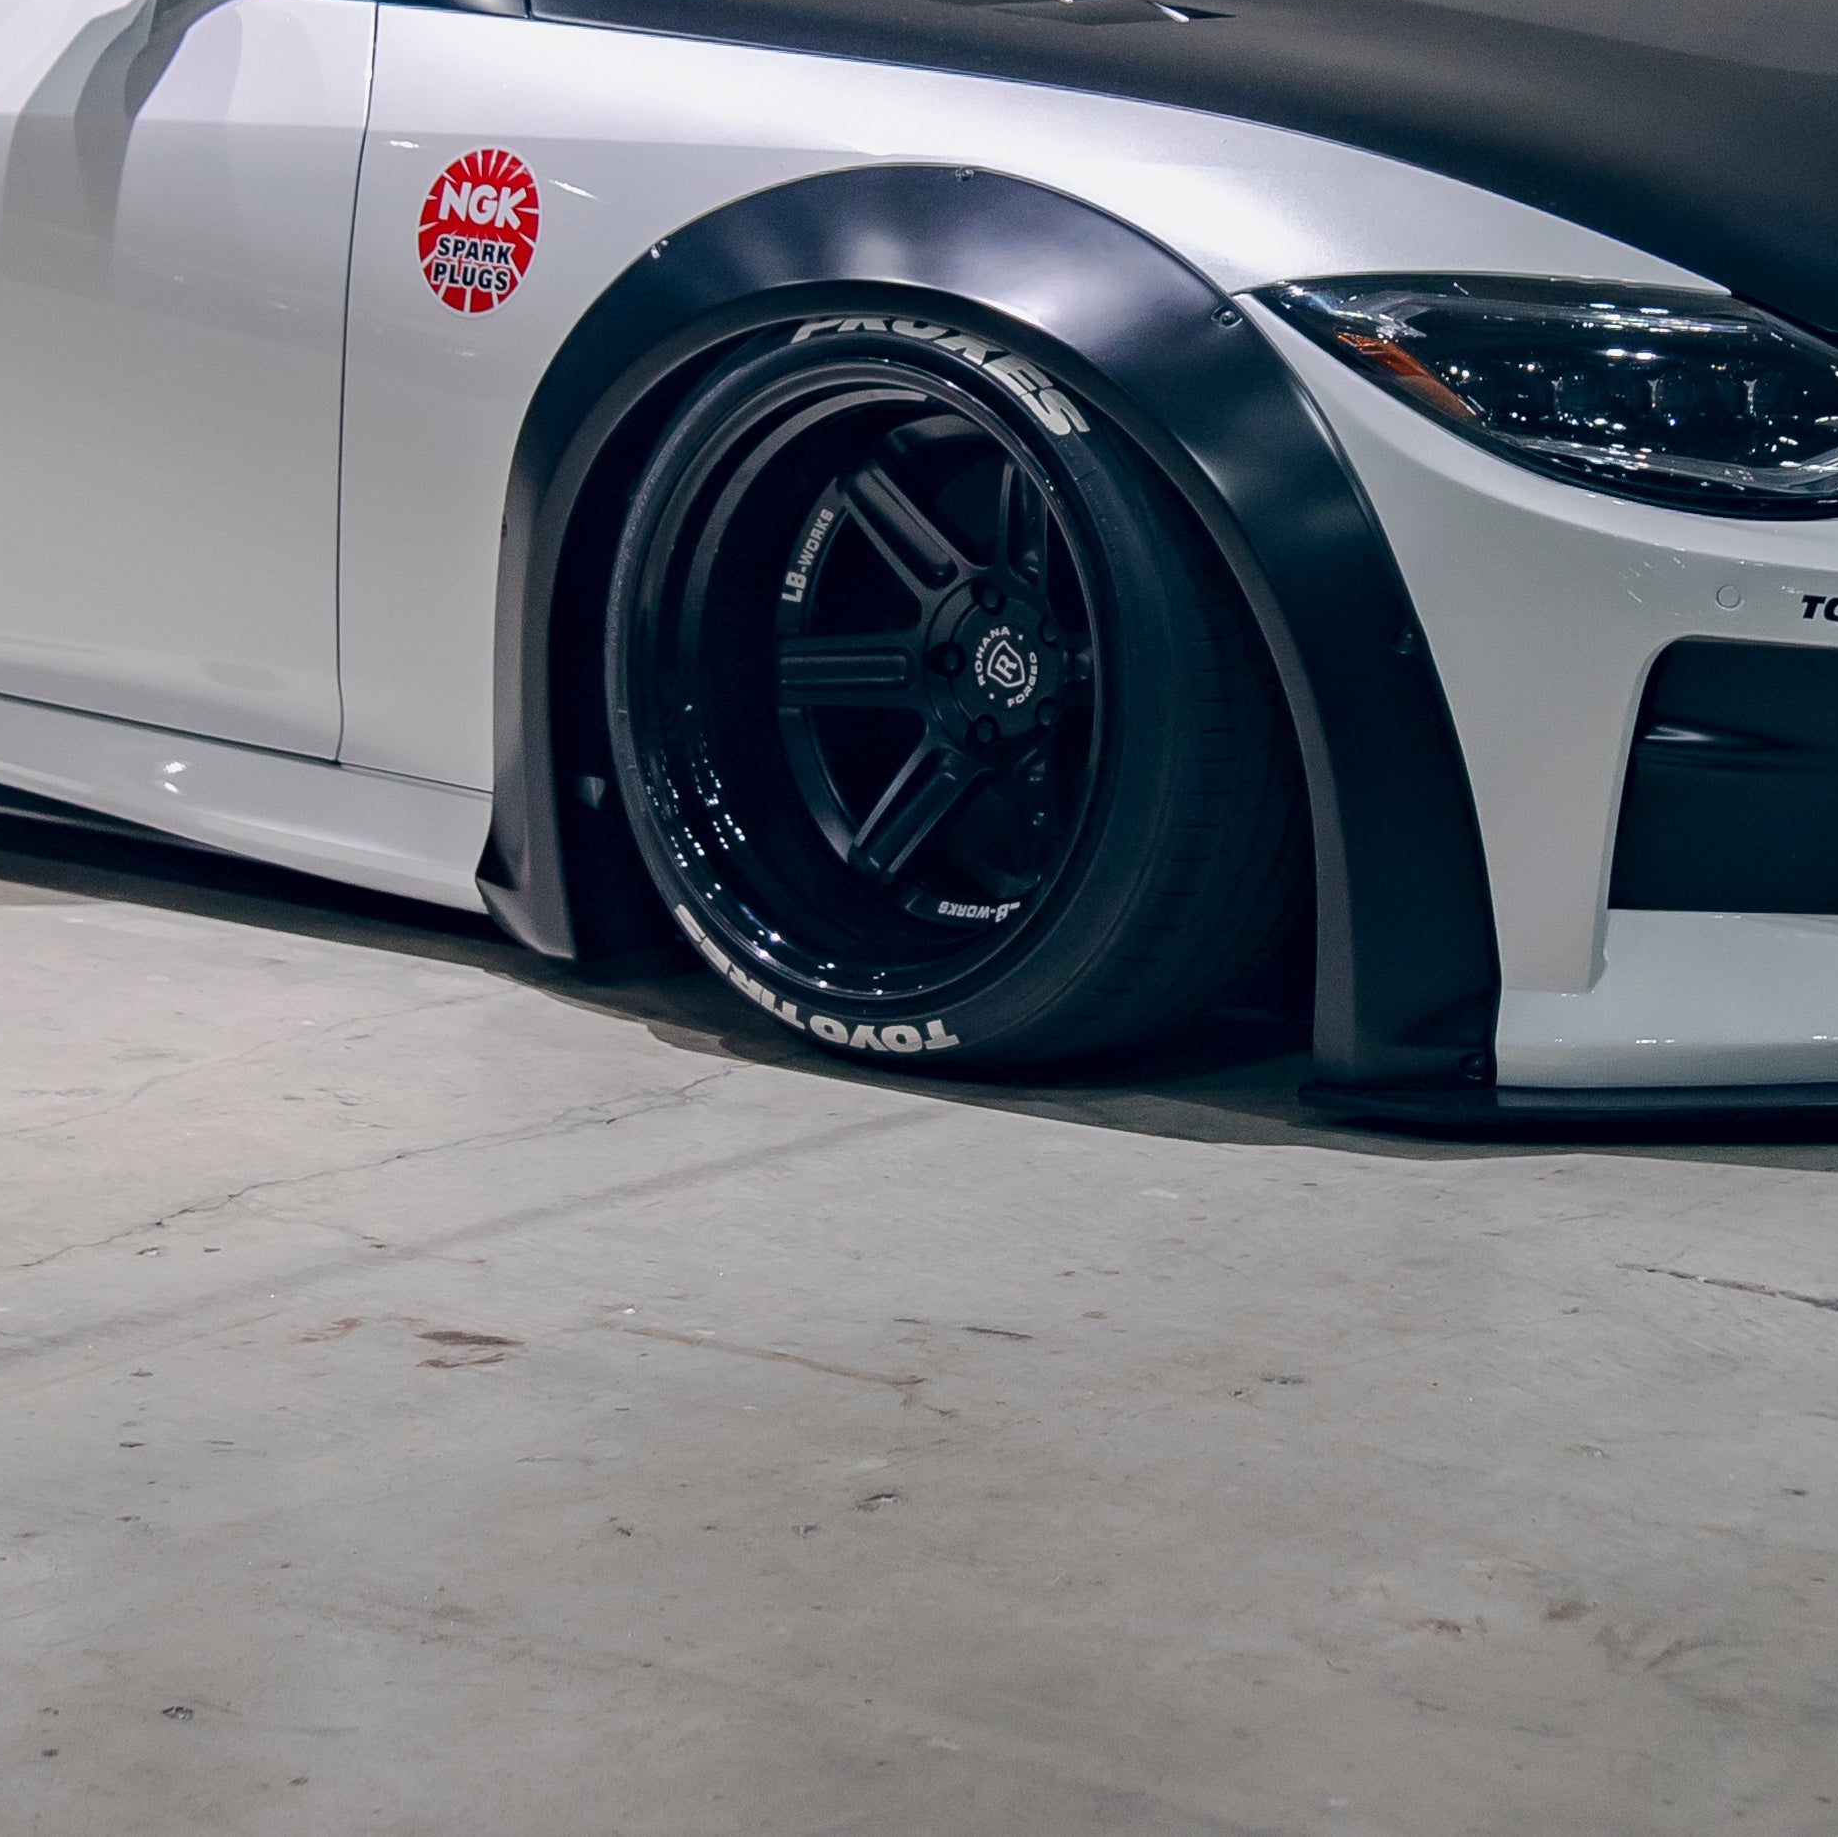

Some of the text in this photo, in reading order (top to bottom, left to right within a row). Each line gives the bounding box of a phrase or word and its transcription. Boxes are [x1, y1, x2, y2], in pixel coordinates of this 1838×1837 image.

[437, 180, 528, 230] NGK
[436, 235, 513, 266] SPARK
[431, 262, 510, 292] PLUGS
[780, 508, 834, 603] LB-WORKS
[974, 625, 1011, 687] ROHANA
[1006, 651, 1038, 708] FORGED
[809, 1014, 960, 1053] TOYO
